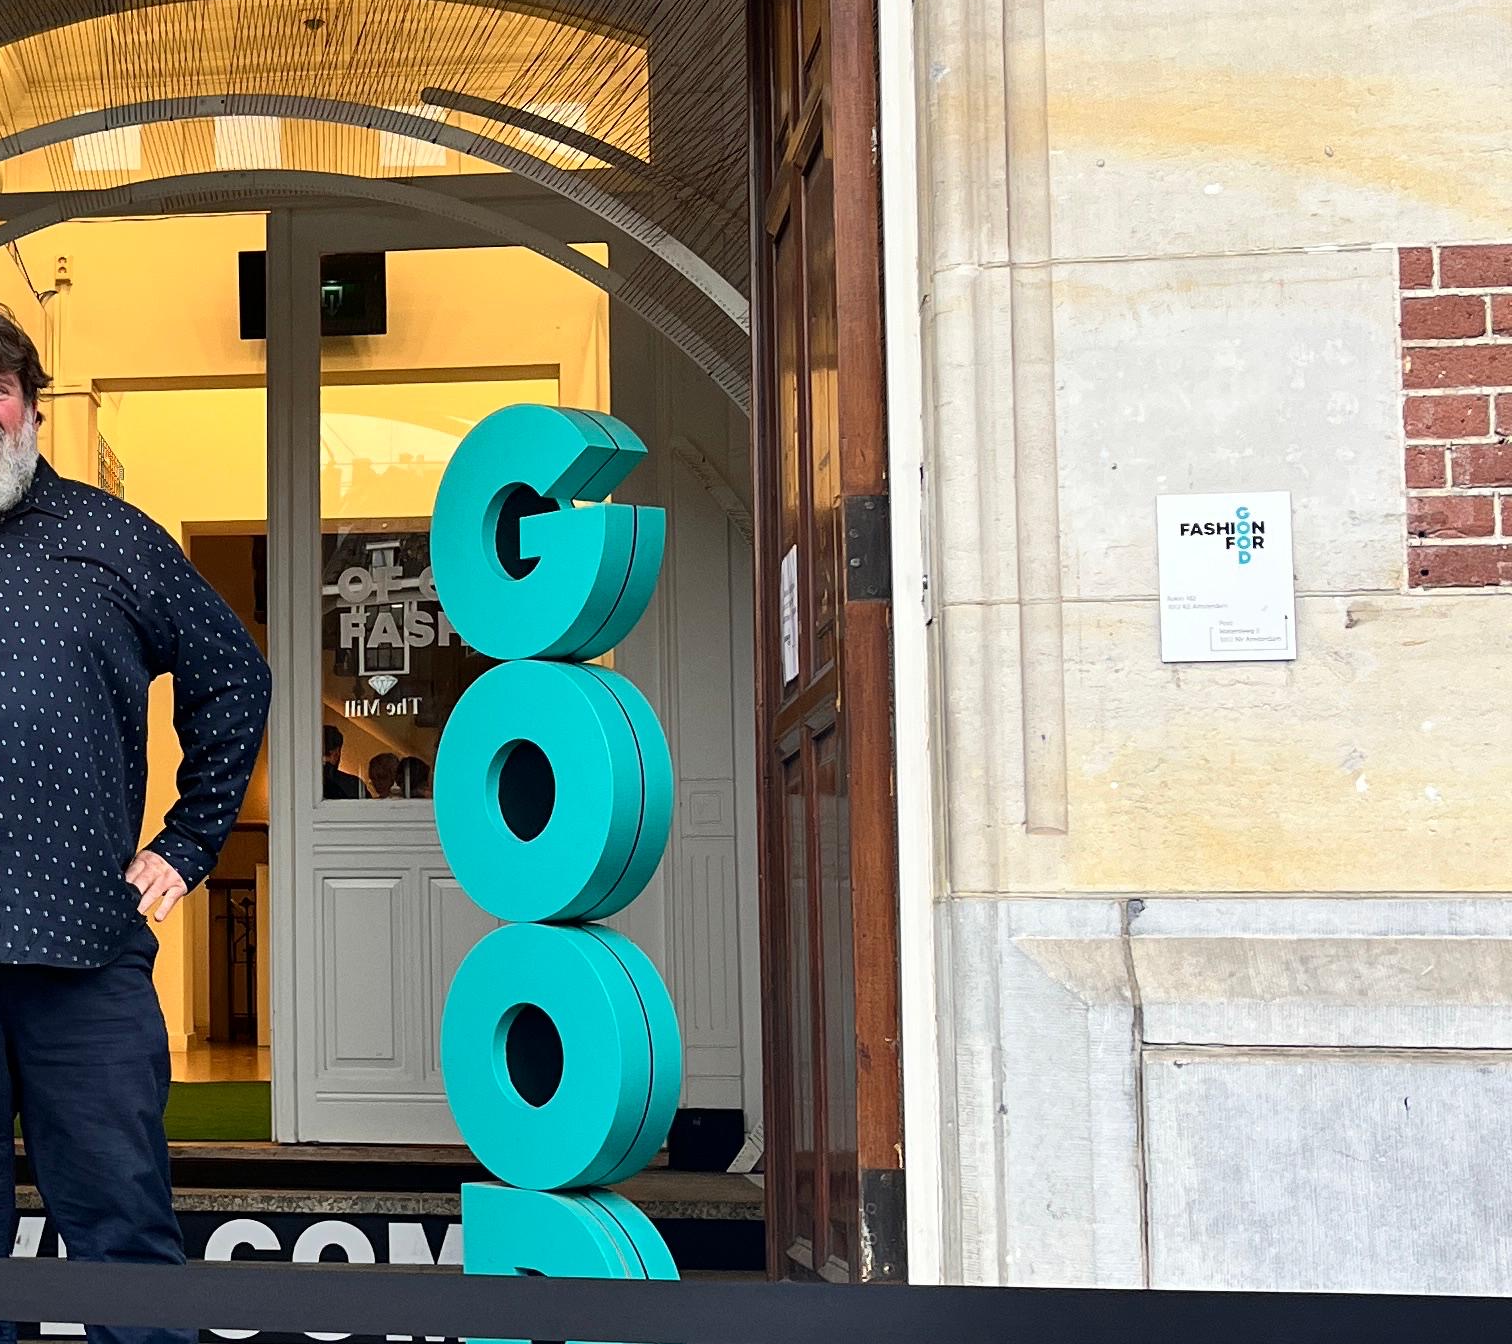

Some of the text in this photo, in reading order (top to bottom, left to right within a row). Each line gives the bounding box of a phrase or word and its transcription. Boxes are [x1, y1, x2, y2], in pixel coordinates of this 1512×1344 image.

[1180, 520, 1266, 537] FASHION
[1235, 506, 1252, 565] GOOD
[1226, 535, 1265, 550] FOR
